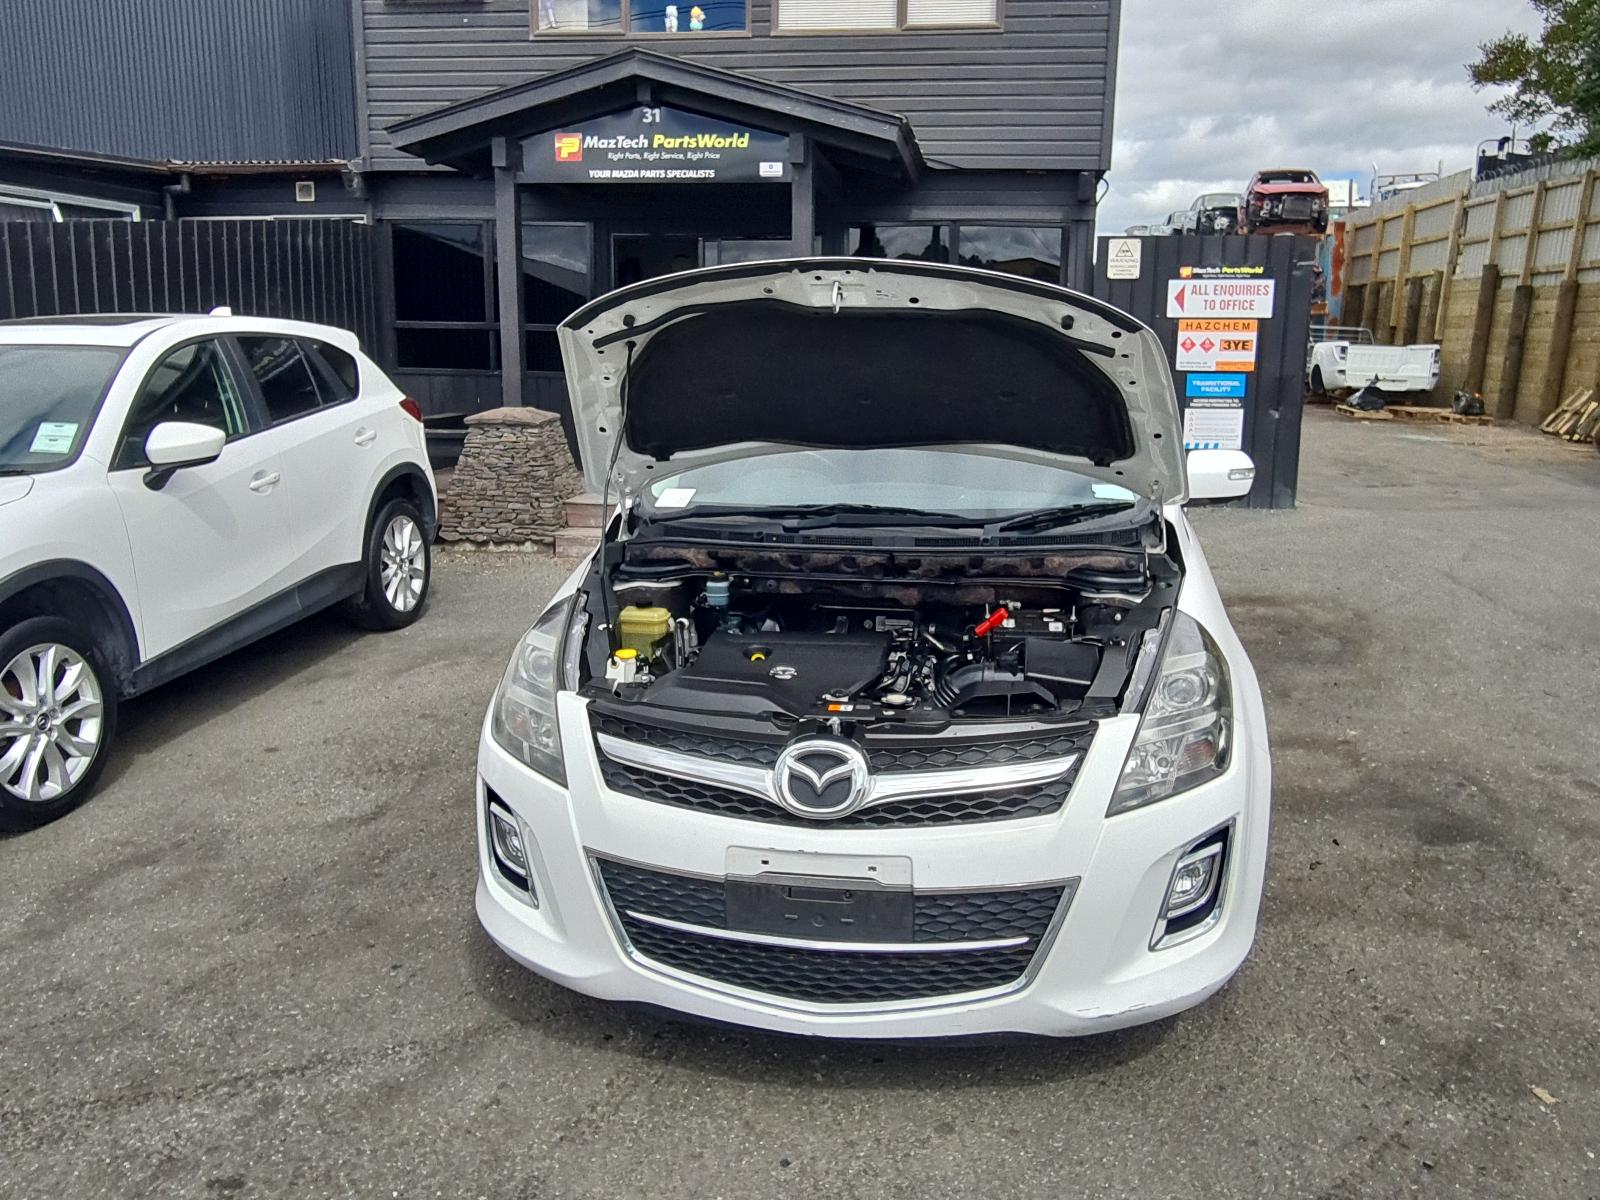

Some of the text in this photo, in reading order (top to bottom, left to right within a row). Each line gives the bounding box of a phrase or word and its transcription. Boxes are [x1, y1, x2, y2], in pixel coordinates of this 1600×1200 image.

[642, 108, 660, 123] 31
[583, 133, 649, 149] MazTech
[652, 132, 750, 148] PartsWorld
[607, 151, 624, 161] Right
[643, 151, 660, 161] Right
[660, 151, 685, 160] Service,
[686, 151, 703, 161] Right
[704, 152, 720, 160] Price
[589, 169, 716, 178] YOUR MAZDA PARTS SPECIALISTS
[1190, 284, 1270, 297] ALL ENQUIRIES
[1203, 299, 1256, 311] TO OFFICE
[1185, 321, 1251, 331] HAZCHEM
[1223, 340, 1250, 351] 3YE
